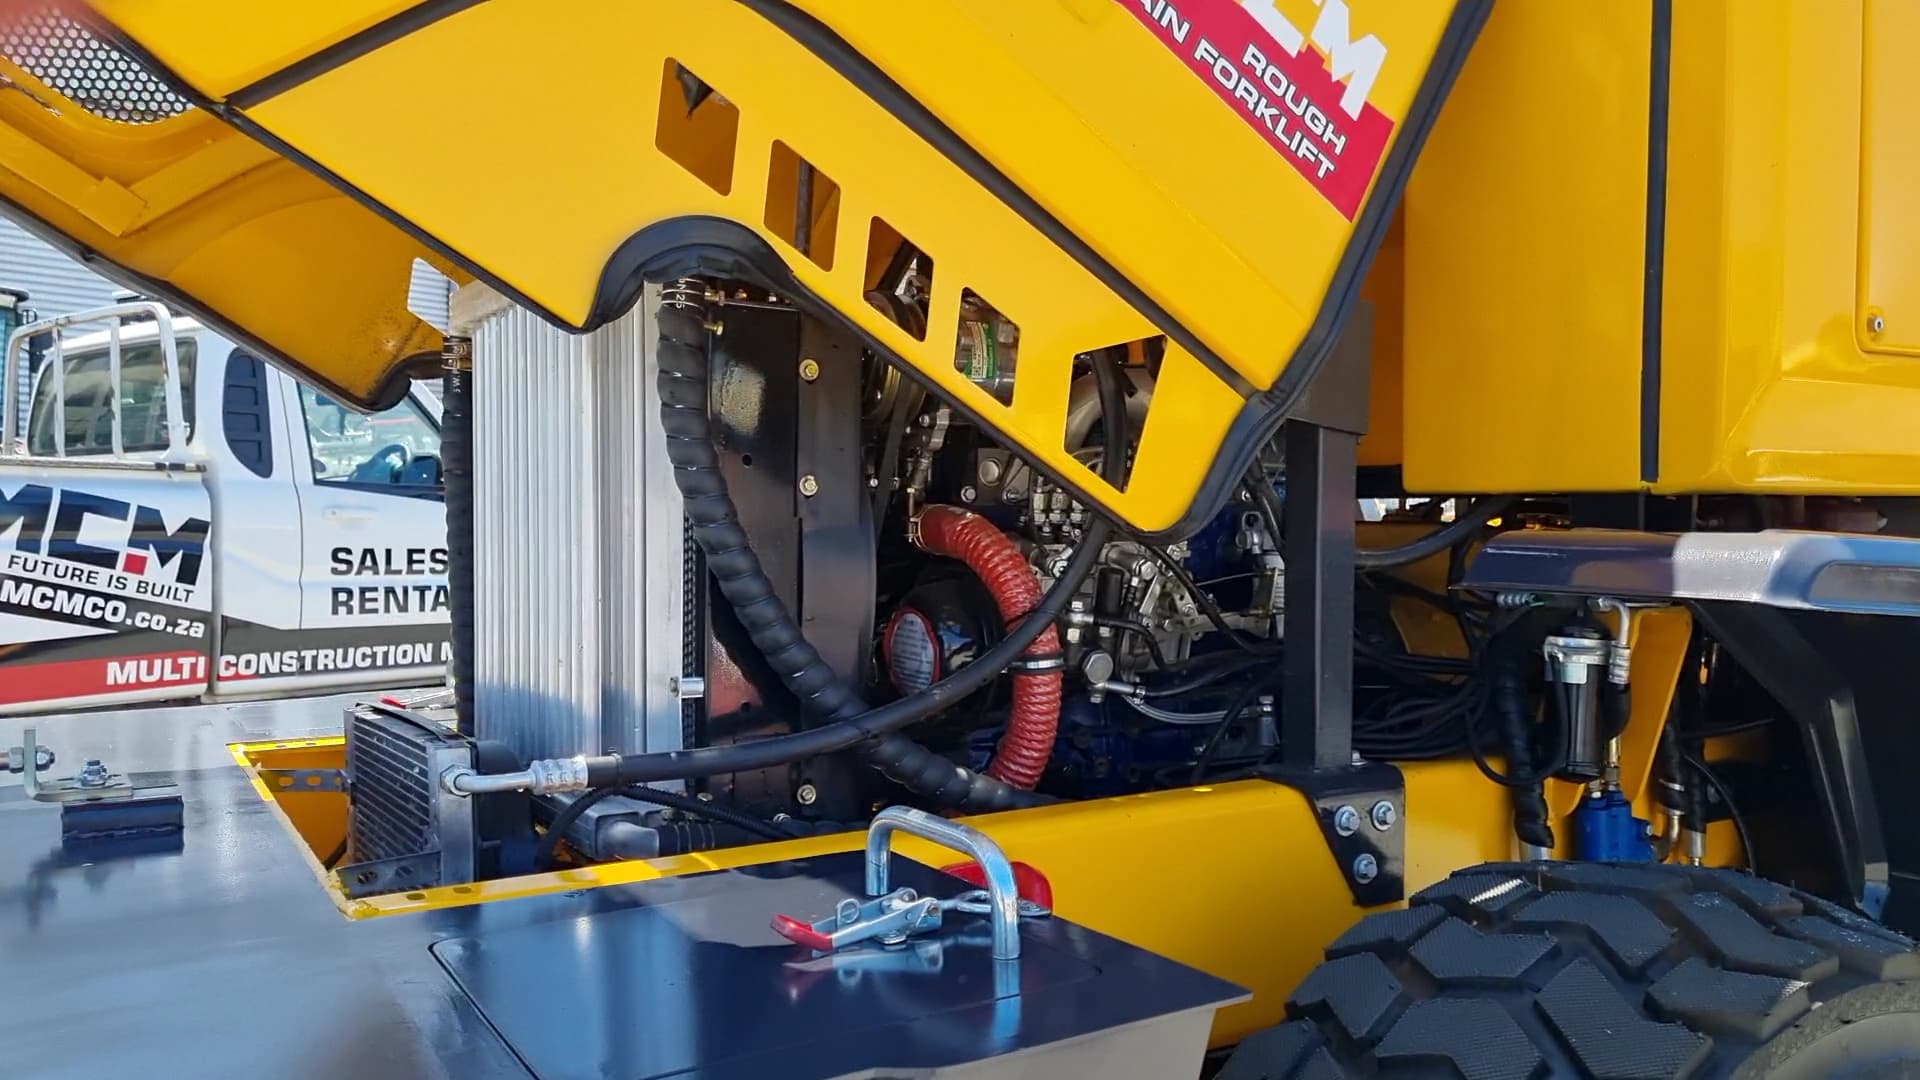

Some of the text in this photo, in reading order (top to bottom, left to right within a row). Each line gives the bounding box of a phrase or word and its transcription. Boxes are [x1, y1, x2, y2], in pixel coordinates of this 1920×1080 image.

[1194, 38, 1335, 179] FORKLIFT
[1242, 43, 1346, 154] ROUGH
[8, 555, 194, 604] FUTURE IS BUILT
[330, 547, 448, 576] SALES
[1, 580, 205, 638] MCMCO.co.za
[331, 585, 450, 616] RENTA
[106, 656, 205, 686] MULTI
[218, 642, 433, 678] CONSTRUCTION
